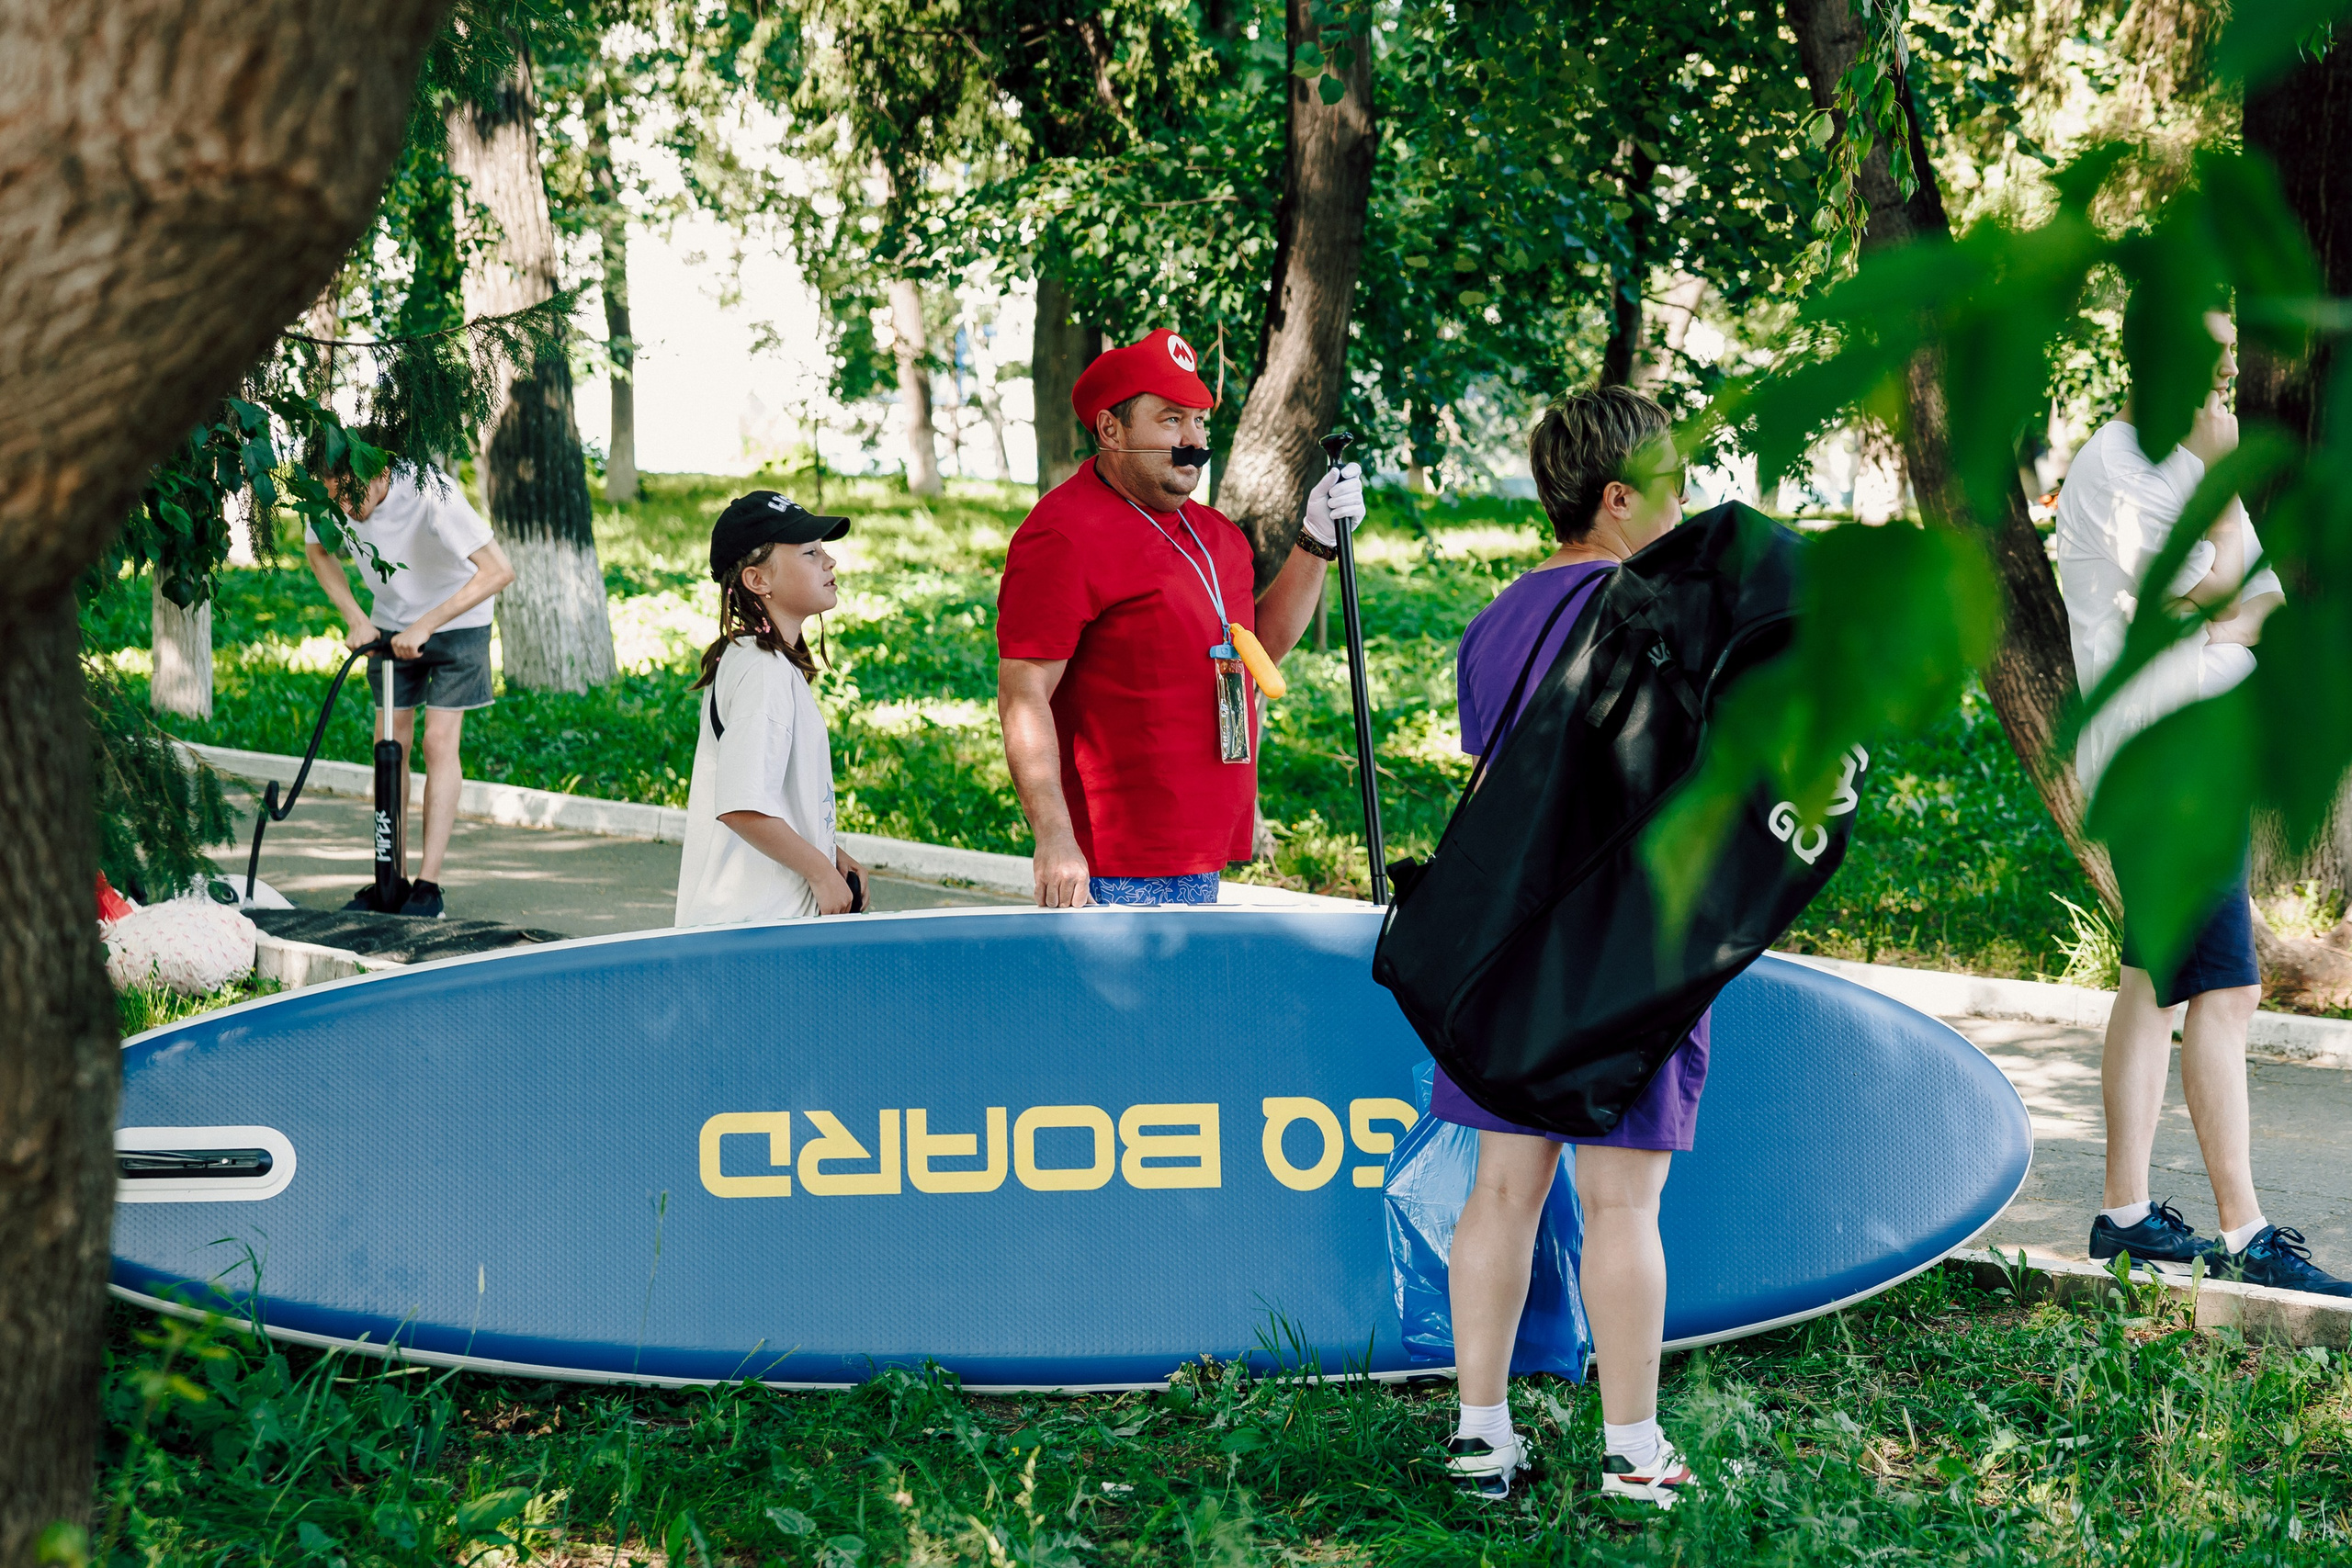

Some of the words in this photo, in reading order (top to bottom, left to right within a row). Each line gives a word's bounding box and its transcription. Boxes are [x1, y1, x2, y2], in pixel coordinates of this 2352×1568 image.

[1172, 342, 1193, 364] M
[375, 809, 392, 863] HIPER
[1769, 801, 1828, 865] GQ
[699, 1103, 1222, 1199] BOARD
